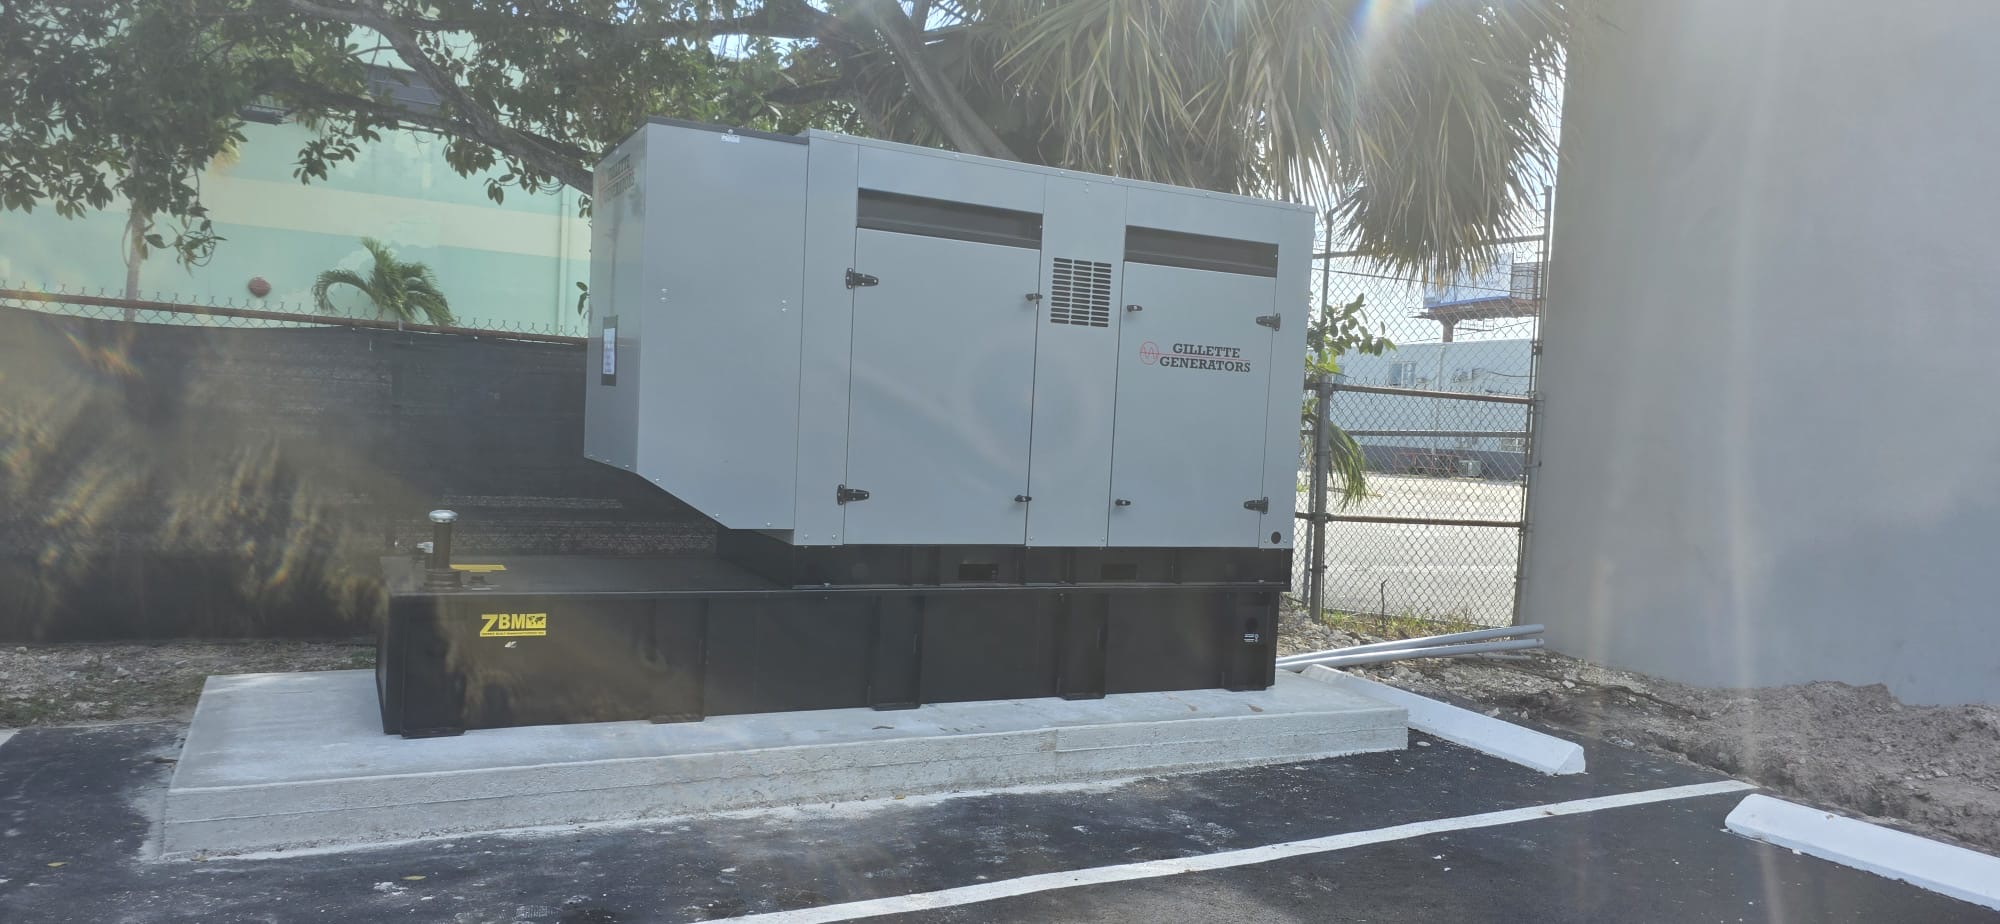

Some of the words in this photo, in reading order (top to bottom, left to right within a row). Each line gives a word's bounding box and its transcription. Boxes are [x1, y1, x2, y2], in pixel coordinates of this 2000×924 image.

[1172, 343, 1241, 359] GILLETTE
[1159, 356, 1251, 373] GENERATORS
[479, 613, 526, 635] ZBM
